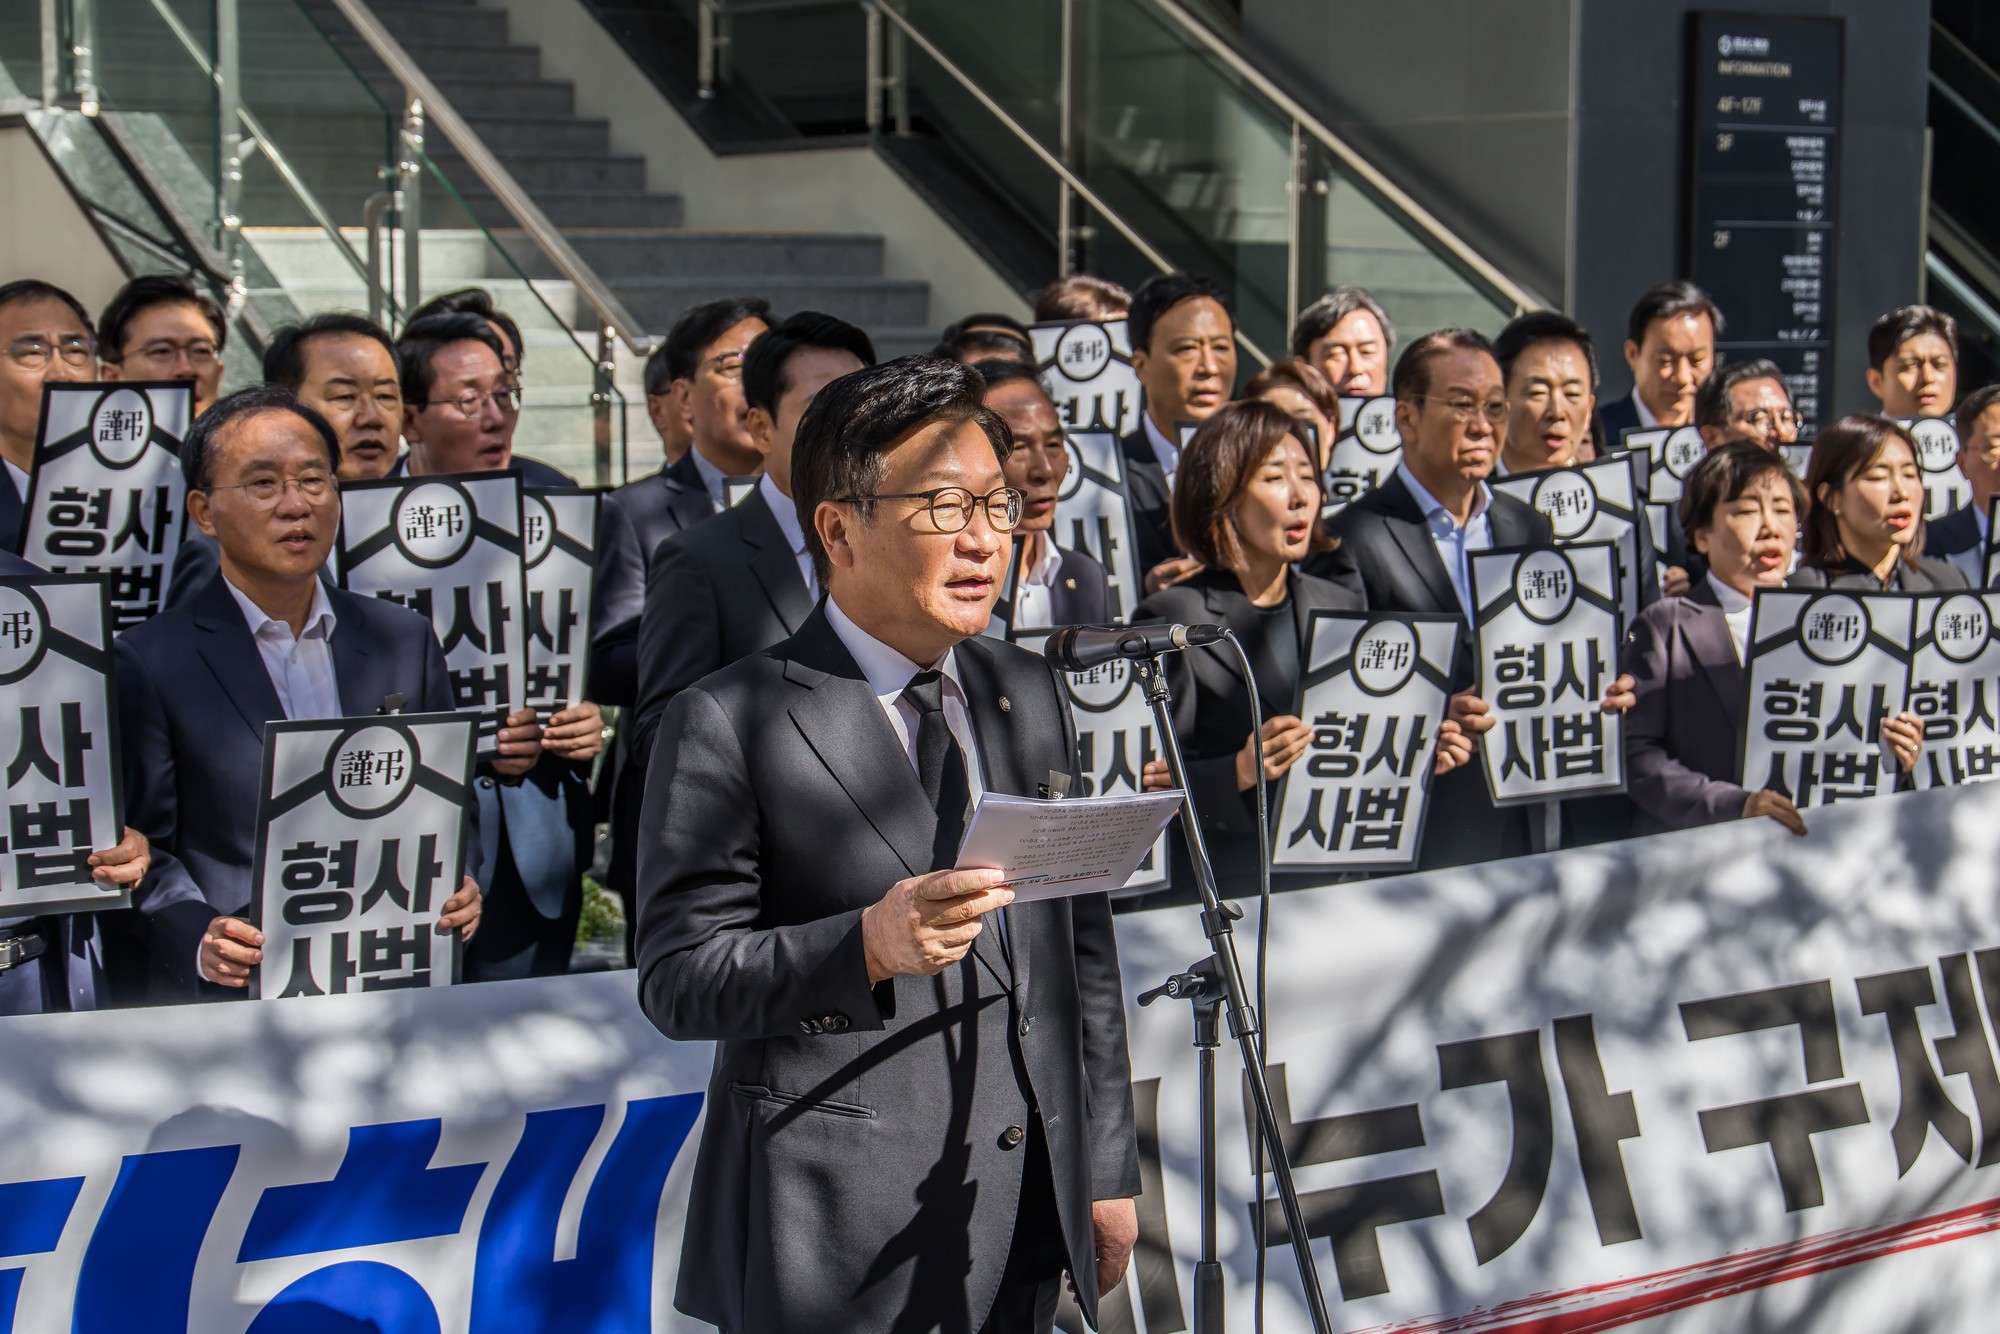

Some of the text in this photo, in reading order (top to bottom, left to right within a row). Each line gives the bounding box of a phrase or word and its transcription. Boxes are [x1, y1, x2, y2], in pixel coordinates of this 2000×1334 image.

[1718, 60, 1792, 78] INFORMATION
[99, 409, 143, 442] 謹弔
[44, 485, 173, 556] 형사
[403, 504, 464, 541] 謹弔
[524, 515, 544, 545] 弔
[1524, 569, 1567, 601] 謹弔
[1, 609, 34, 650] 弔
[527, 588, 578, 655] 사
[1360, 639, 1410, 671] 謹弔
[1808, 612, 1859, 642] 謹弔
[1940, 612, 1982, 641] 謹弔
[448, 663, 511, 741] 법
[1494, 637, 1605, 710] 형사
[1306, 711, 1428, 778] 형사
[1763, 678, 1889, 744] 형사
[7, 702, 94, 790] 사
[339, 749, 405, 789] 謹弔
[1501, 709, 1605, 783] 사법
[0, 798, 94, 890] 법
[1287, 785, 1411, 852] 사법
[281, 833, 443, 926] 형사
[277, 922, 432, 999] 사법
[1241, 1013, 1642, 1302] 누가
